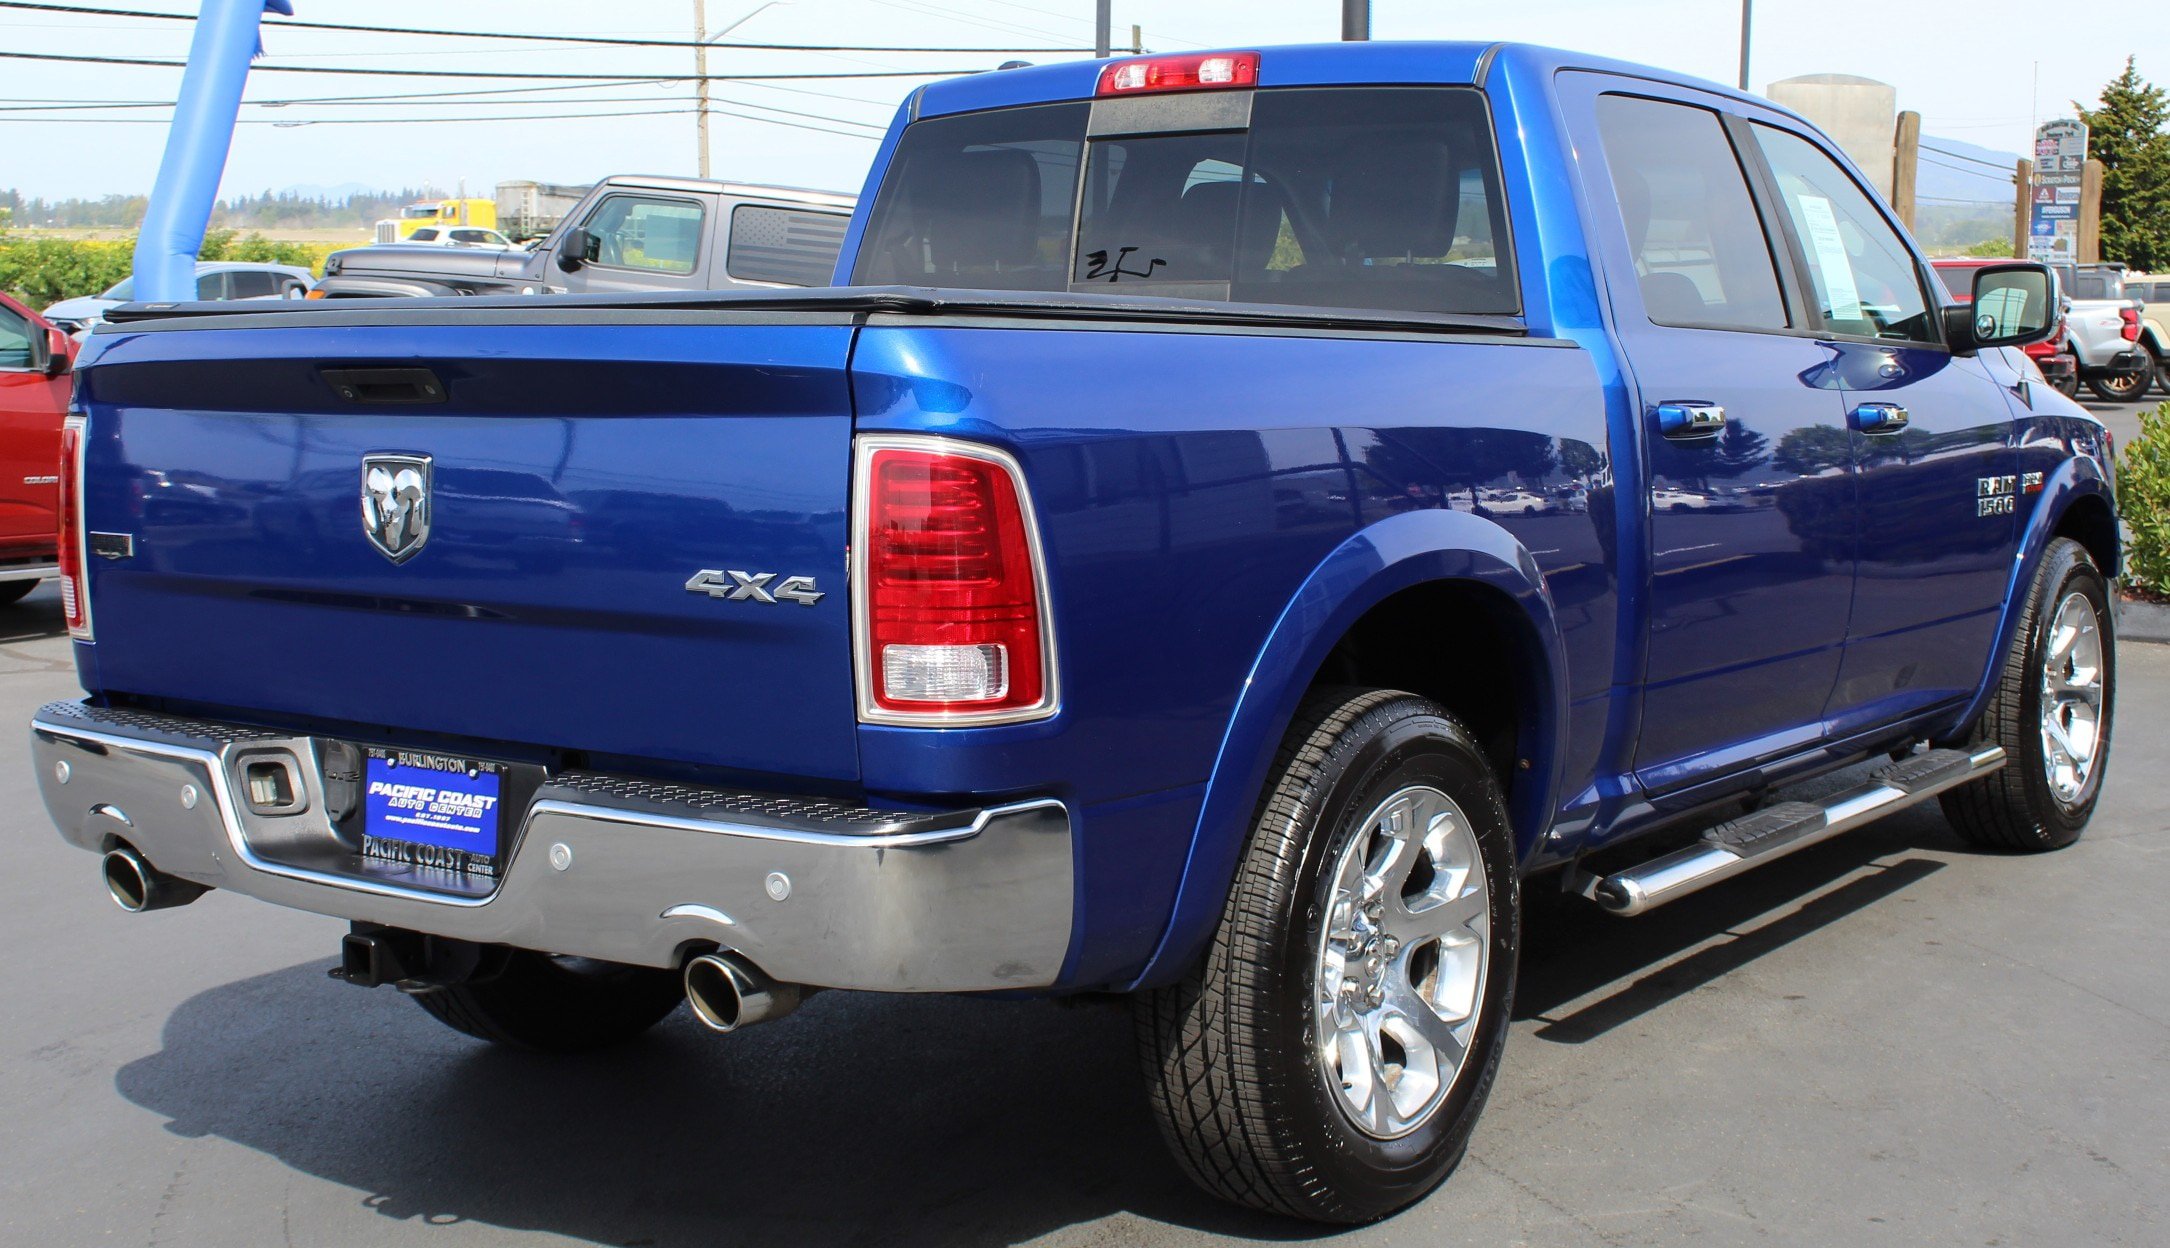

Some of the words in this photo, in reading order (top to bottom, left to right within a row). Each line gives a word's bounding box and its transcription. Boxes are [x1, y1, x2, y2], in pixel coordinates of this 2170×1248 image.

[1978, 475, 2016, 497] RAM
[1978, 495, 2015, 517] 1500
[685, 568, 826, 606] 4X4
[398, 752, 467, 774] BURLINGTON
[369, 781, 436, 802] PACIFIC
[437, 790, 497, 810] COAST
[388, 796, 425, 811] AUTO
[428, 803, 483, 819] CENTER
[362, 833, 411, 863] PACIFIC
[415, 842, 464, 870] COAST
[469, 853, 490, 864] AUTO
[467, 862, 494, 876] CENTER
